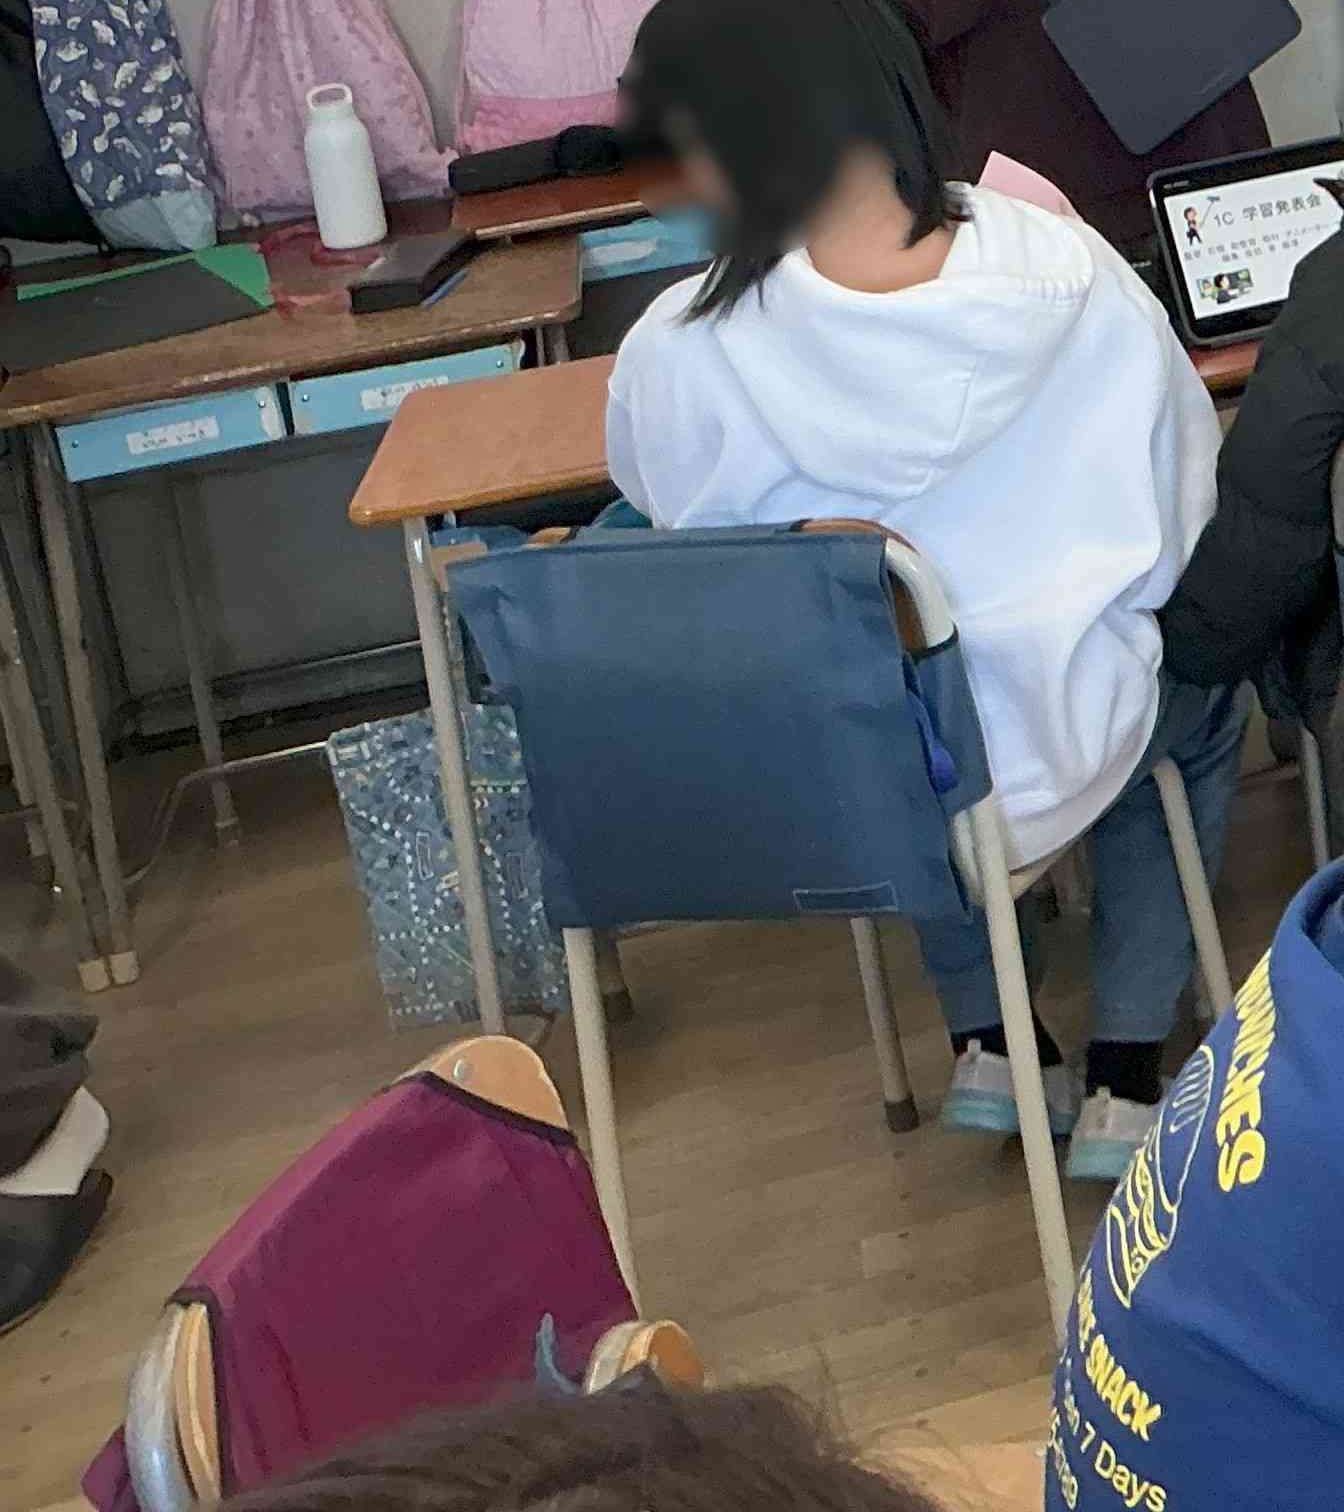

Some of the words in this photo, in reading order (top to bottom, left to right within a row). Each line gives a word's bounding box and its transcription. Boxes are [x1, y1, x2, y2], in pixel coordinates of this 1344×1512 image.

[1214, 211, 1234, 228] 1C
[1242, 193, 1322, 221] 学習発表会
[1085, 1334, 1162, 1442] SNACK
[1080, 1420, 1097, 1454] 7
[1094, 1440, 1168, 1512] Days
